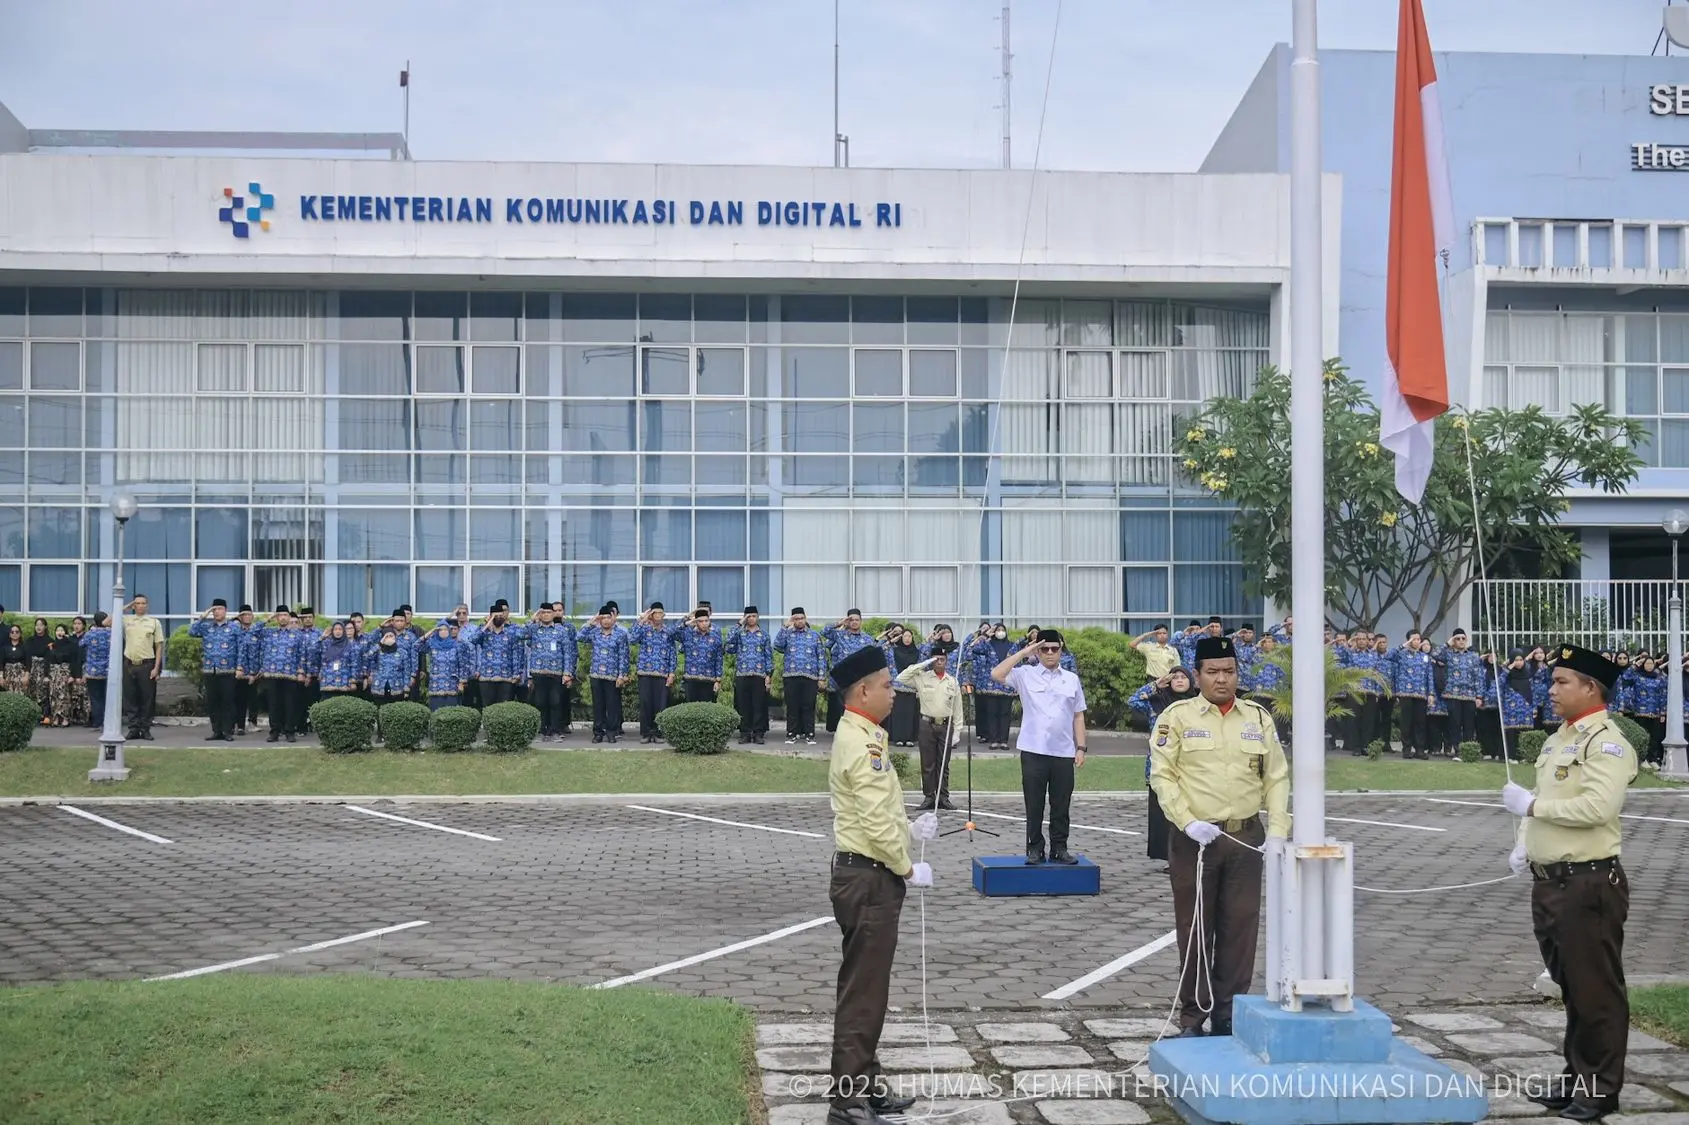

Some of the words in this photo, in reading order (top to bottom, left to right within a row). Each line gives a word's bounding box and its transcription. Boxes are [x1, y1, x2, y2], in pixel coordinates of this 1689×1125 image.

[1631, 143, 1686, 168] The
[300, 195, 492, 222] KEMENTERIAN
[506, 198, 675, 224] KOMUNIKASI
[689, 201, 743, 225] DAN
[758, 202, 862, 227] DIGITAL
[877, 203, 901, 227] RI
